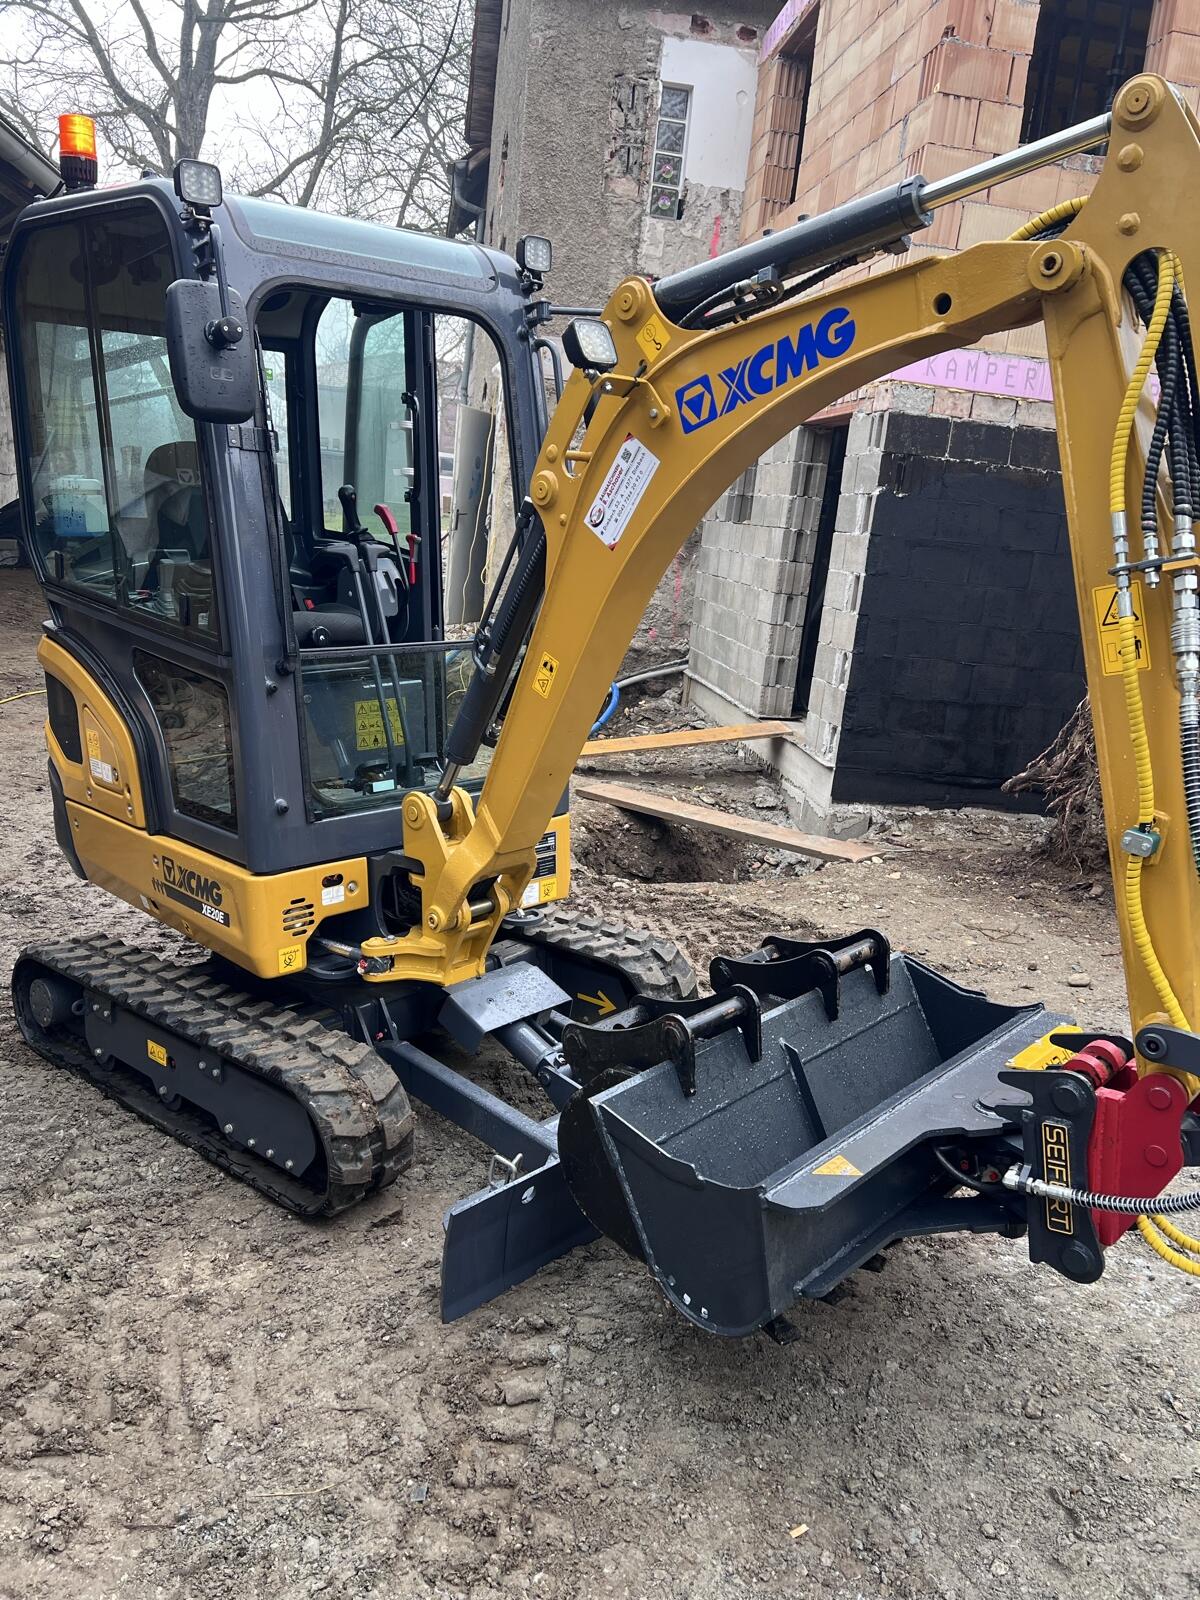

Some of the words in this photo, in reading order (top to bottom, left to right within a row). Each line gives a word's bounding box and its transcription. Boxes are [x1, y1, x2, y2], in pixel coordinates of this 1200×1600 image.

[717, 307, 855, 417] XCMG
[925, 355, 1037, 391] KAMPER
[605, 465, 624, 498] Aschauer
[175, 865, 223, 907] XCMG
[201, 903, 225, 924] XE20E
